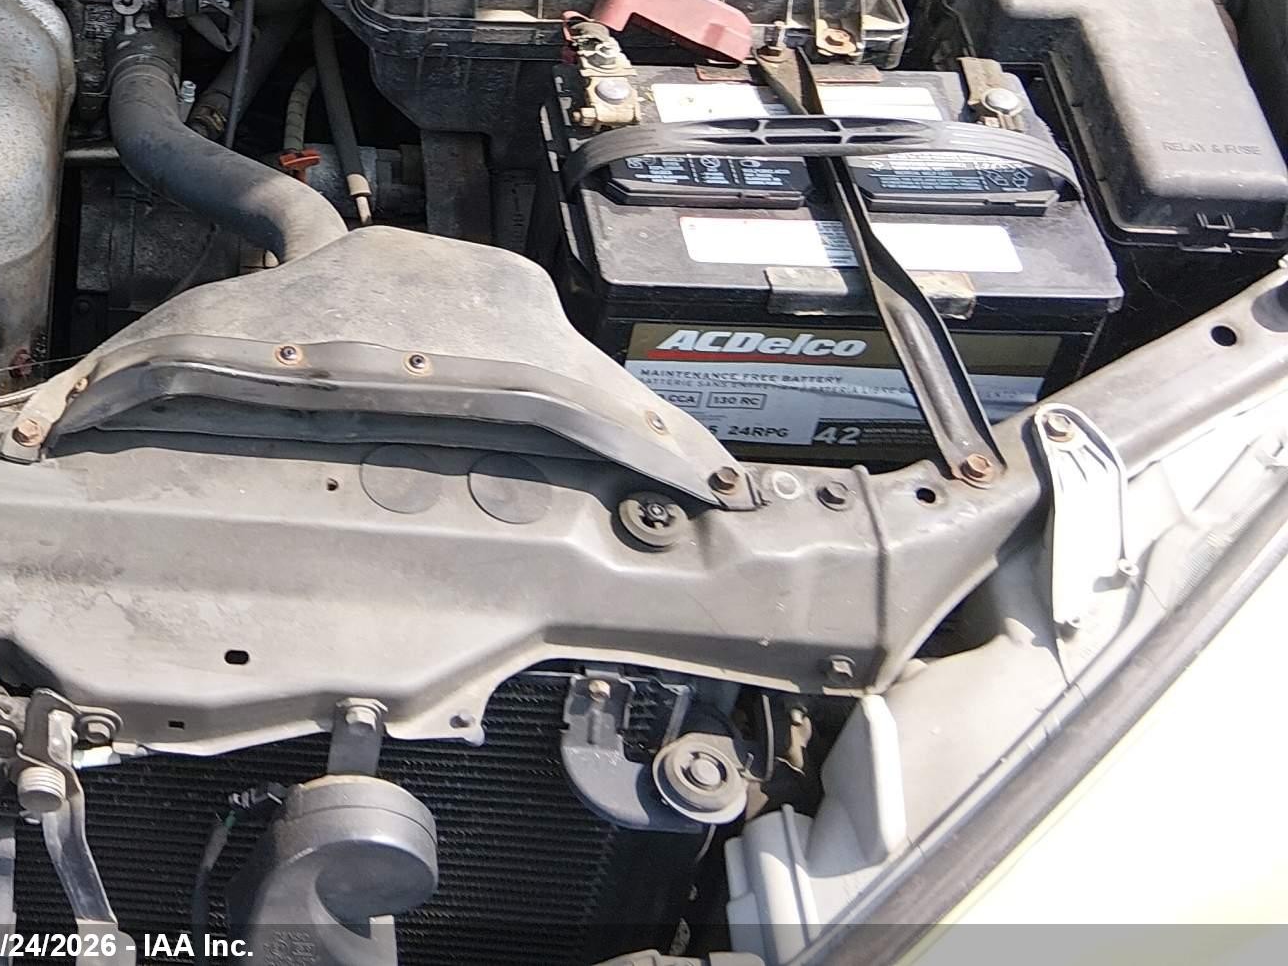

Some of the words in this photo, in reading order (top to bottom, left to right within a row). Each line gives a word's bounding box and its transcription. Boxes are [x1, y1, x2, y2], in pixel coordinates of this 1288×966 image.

[656, 330, 867, 357] ACDelco
[640, 369, 738, 381] MAINTENANCE
[743, 373, 778, 382] FREE
[781, 375, 843, 384] BATTERY
[668, 395, 695, 403] CCA
[713, 396, 737, 405] 130
[740, 397, 760, 406] RC
[728, 425, 790, 438] 24RPG
[813, 427, 861, 444] 42
